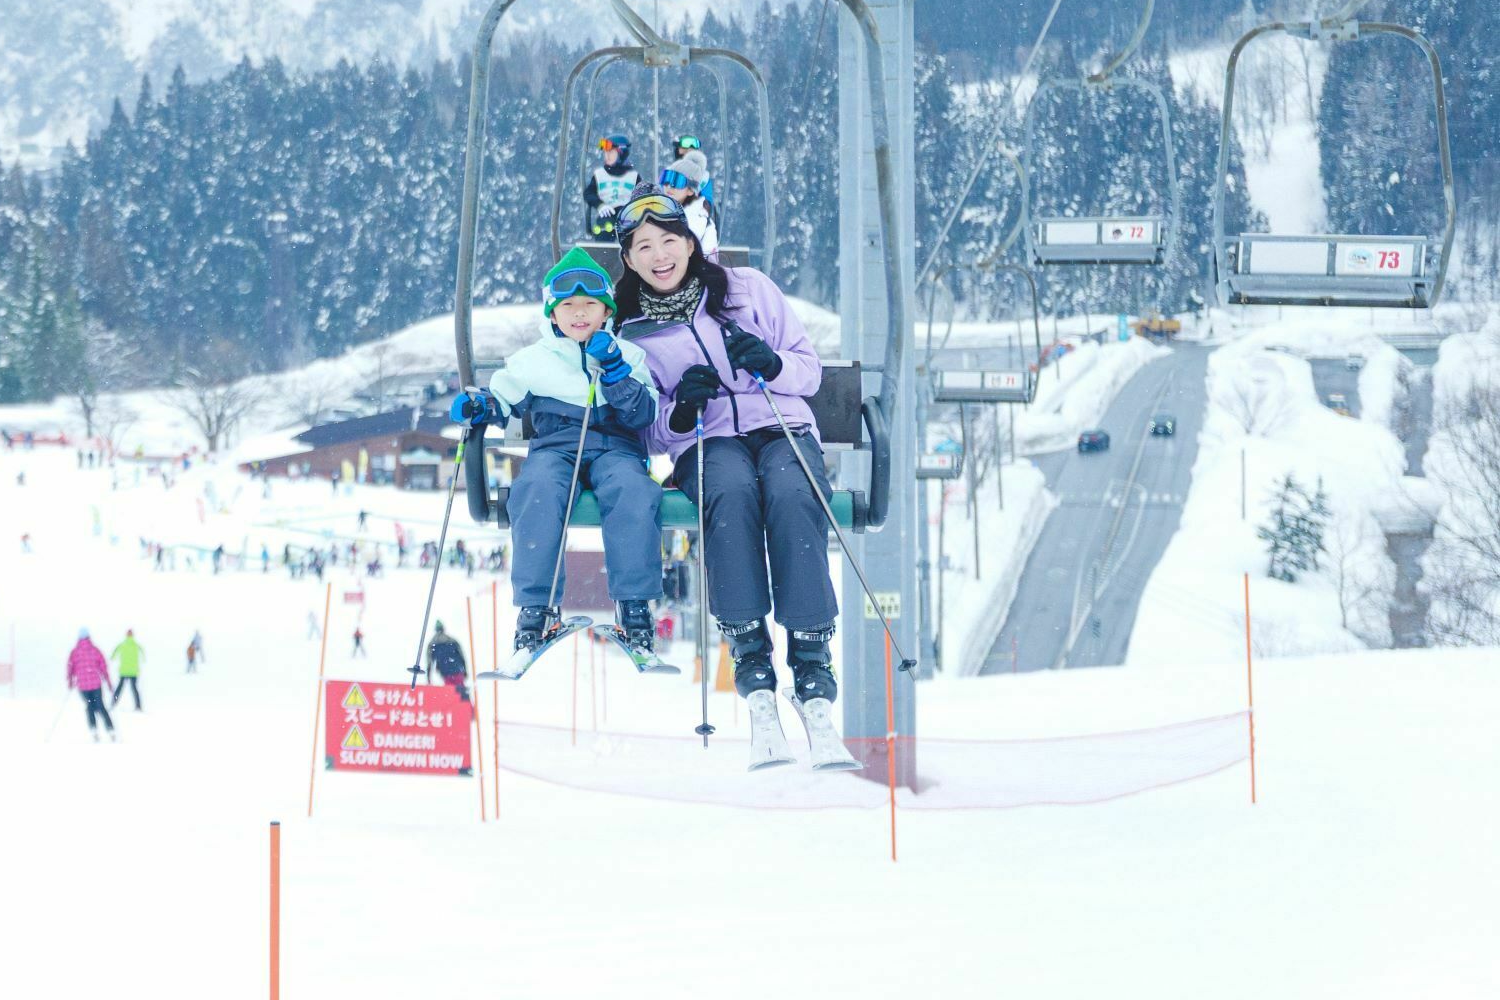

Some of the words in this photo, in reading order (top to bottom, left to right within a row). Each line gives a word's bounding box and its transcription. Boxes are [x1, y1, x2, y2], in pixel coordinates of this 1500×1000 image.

[1129, 226, 1143, 238] 72
[1378, 251, 1400, 269] 73
[373, 733, 435, 750] DANGER!
[340, 751, 379, 766] SLOW
[382, 752, 427, 768] DOWN
[429, 754, 464, 769] NOW
